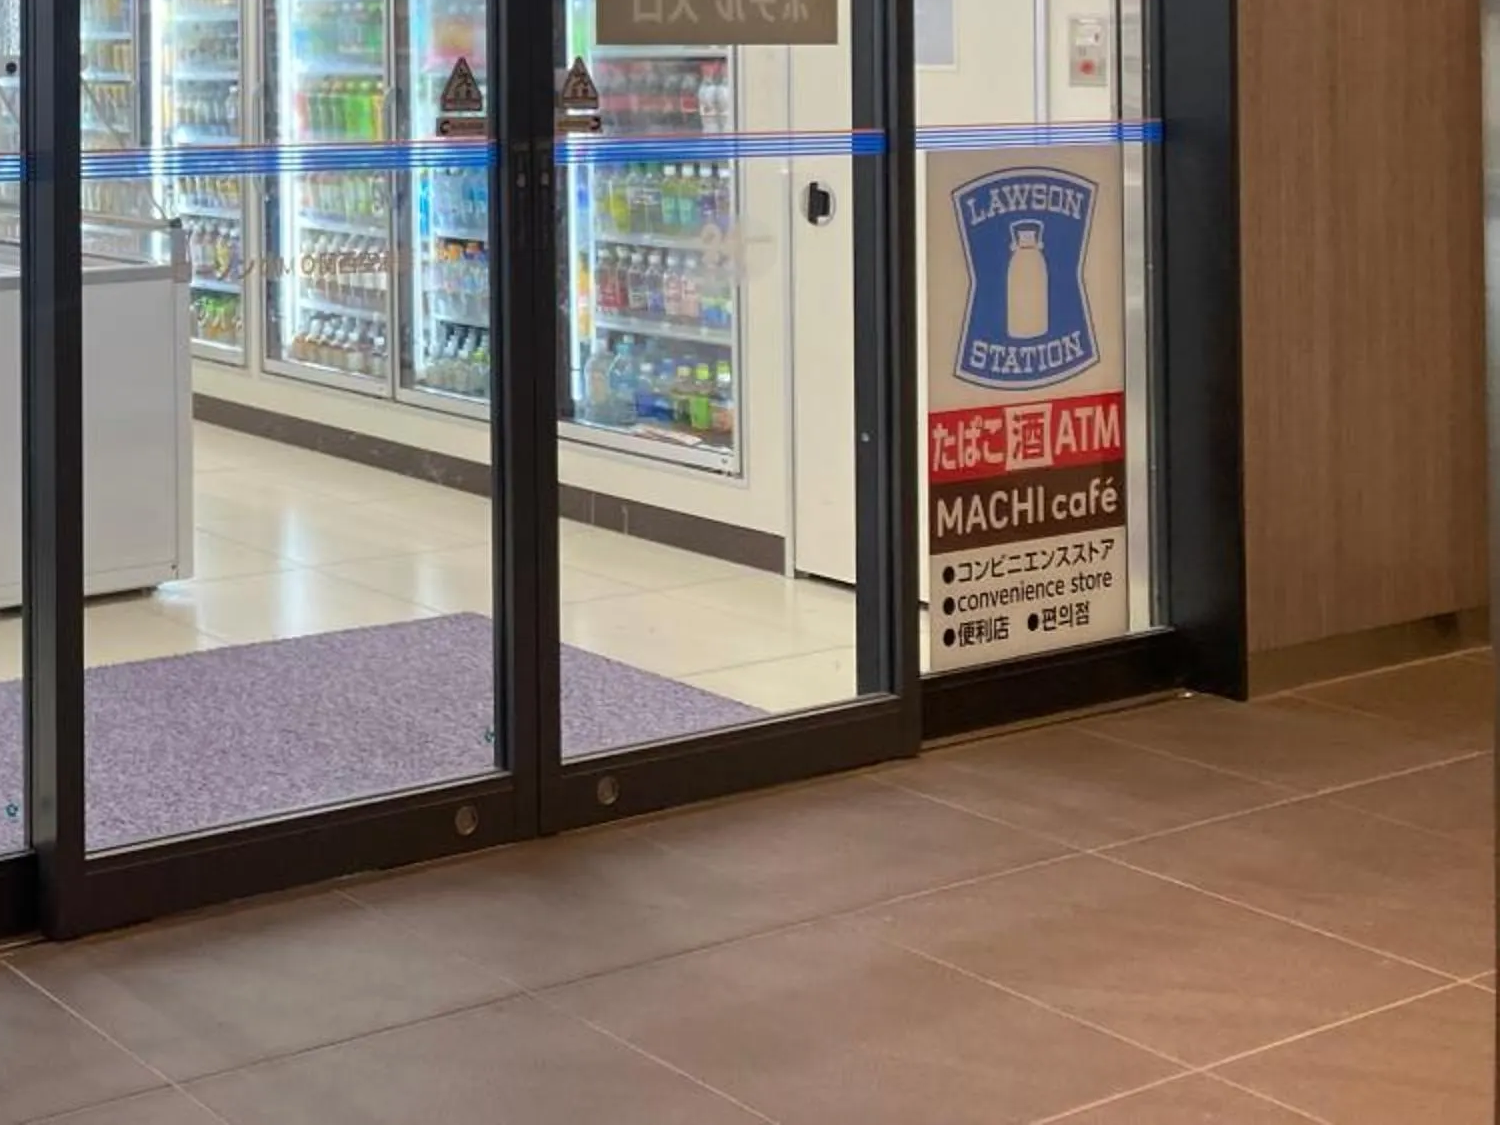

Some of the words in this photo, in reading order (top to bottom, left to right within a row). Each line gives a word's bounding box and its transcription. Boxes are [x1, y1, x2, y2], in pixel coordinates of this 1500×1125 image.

[966, 183, 1085, 226] LAWSON
[969, 331, 1085, 374] STATION
[1055, 402, 1121, 456] ATM
[937, 485, 1045, 539] MACHI
[1051, 477, 1118, 521] café
[958, 538, 1115, 583] コンビニエンスストア
[957, 579, 1066, 613] convenience
[1071, 571, 1113, 594] store
[958, 615, 1011, 648] 便利店
[1041, 600, 1091, 632] 편의점
